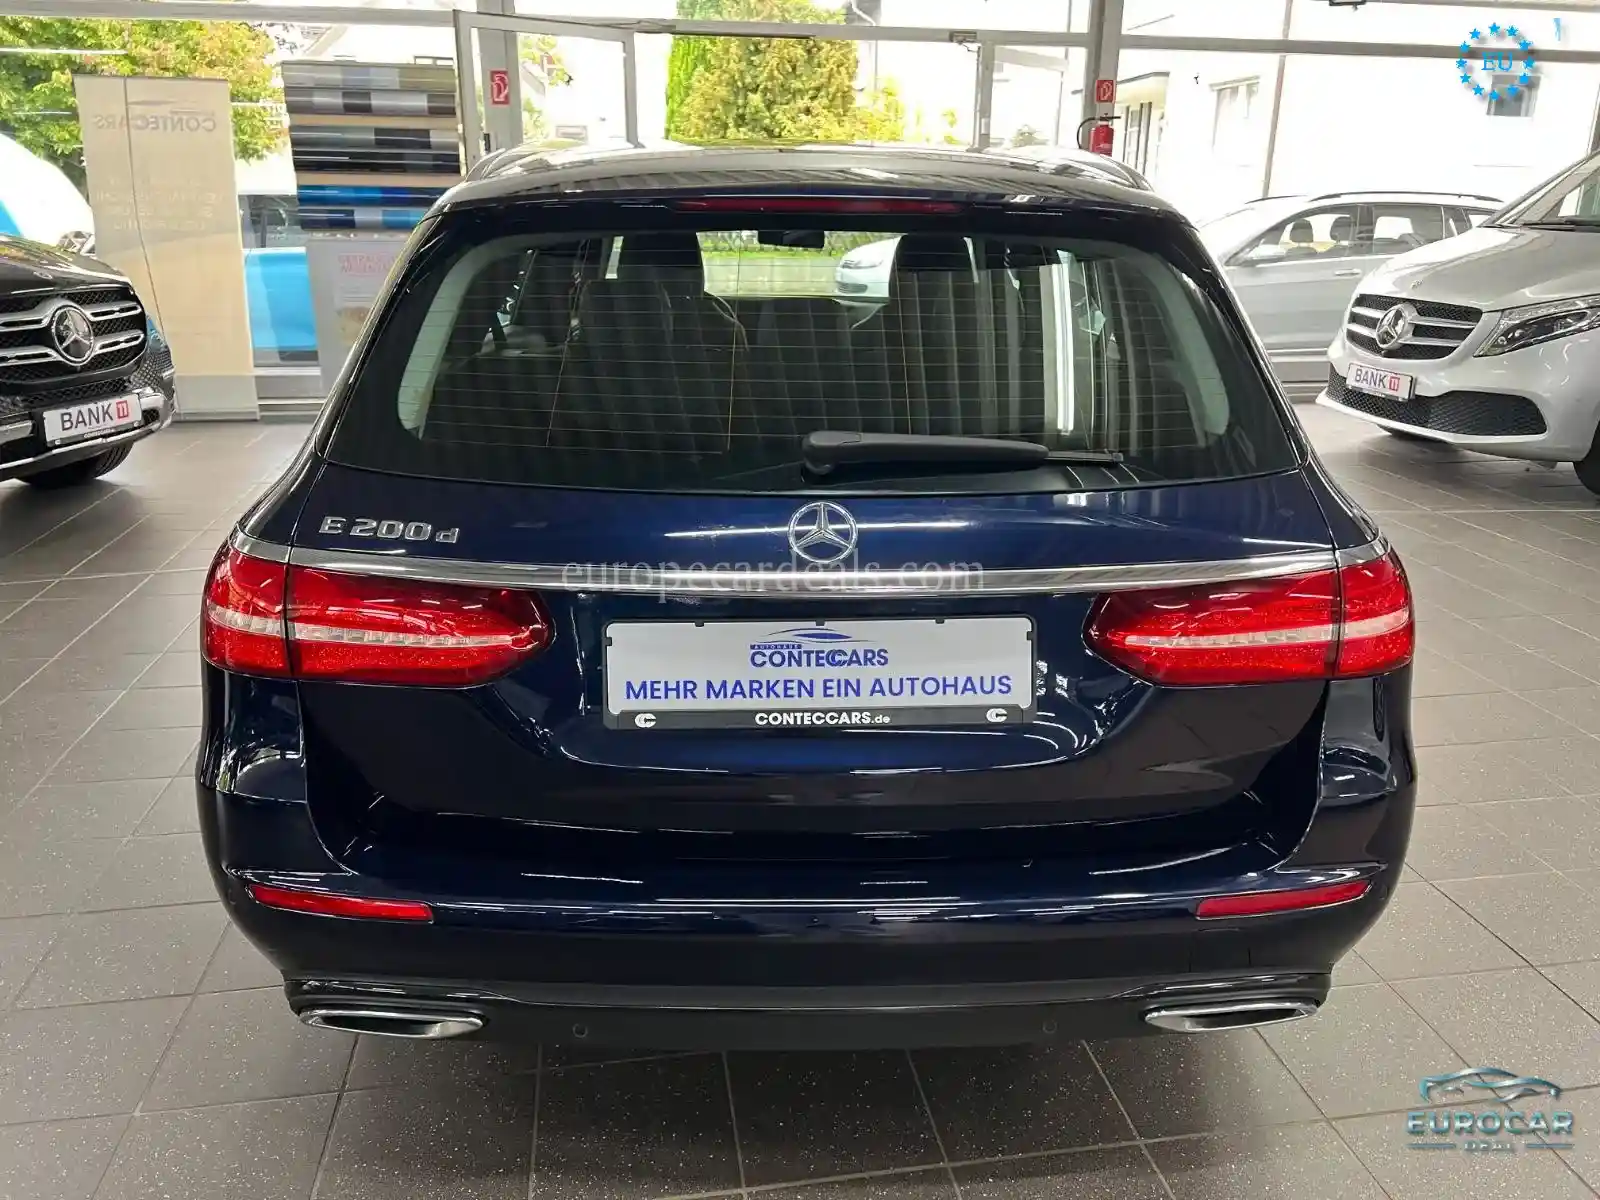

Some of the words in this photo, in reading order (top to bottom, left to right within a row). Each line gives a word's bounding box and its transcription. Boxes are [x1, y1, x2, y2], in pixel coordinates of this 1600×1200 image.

[1355, 368, 1387, 388] BANK
[61, 403, 113, 431] BANK
[319, 516, 346, 534] E
[350, 518, 432, 541] 200
[435, 527, 460, 543] d
[625, 680, 698, 699] MEHR
[706, 679, 814, 699] MARKEN
[823, 678, 861, 698] EIN
[869, 675, 1012, 697] AUTOHAUS
[755, 711, 892, 725] CONTECCARS.de
